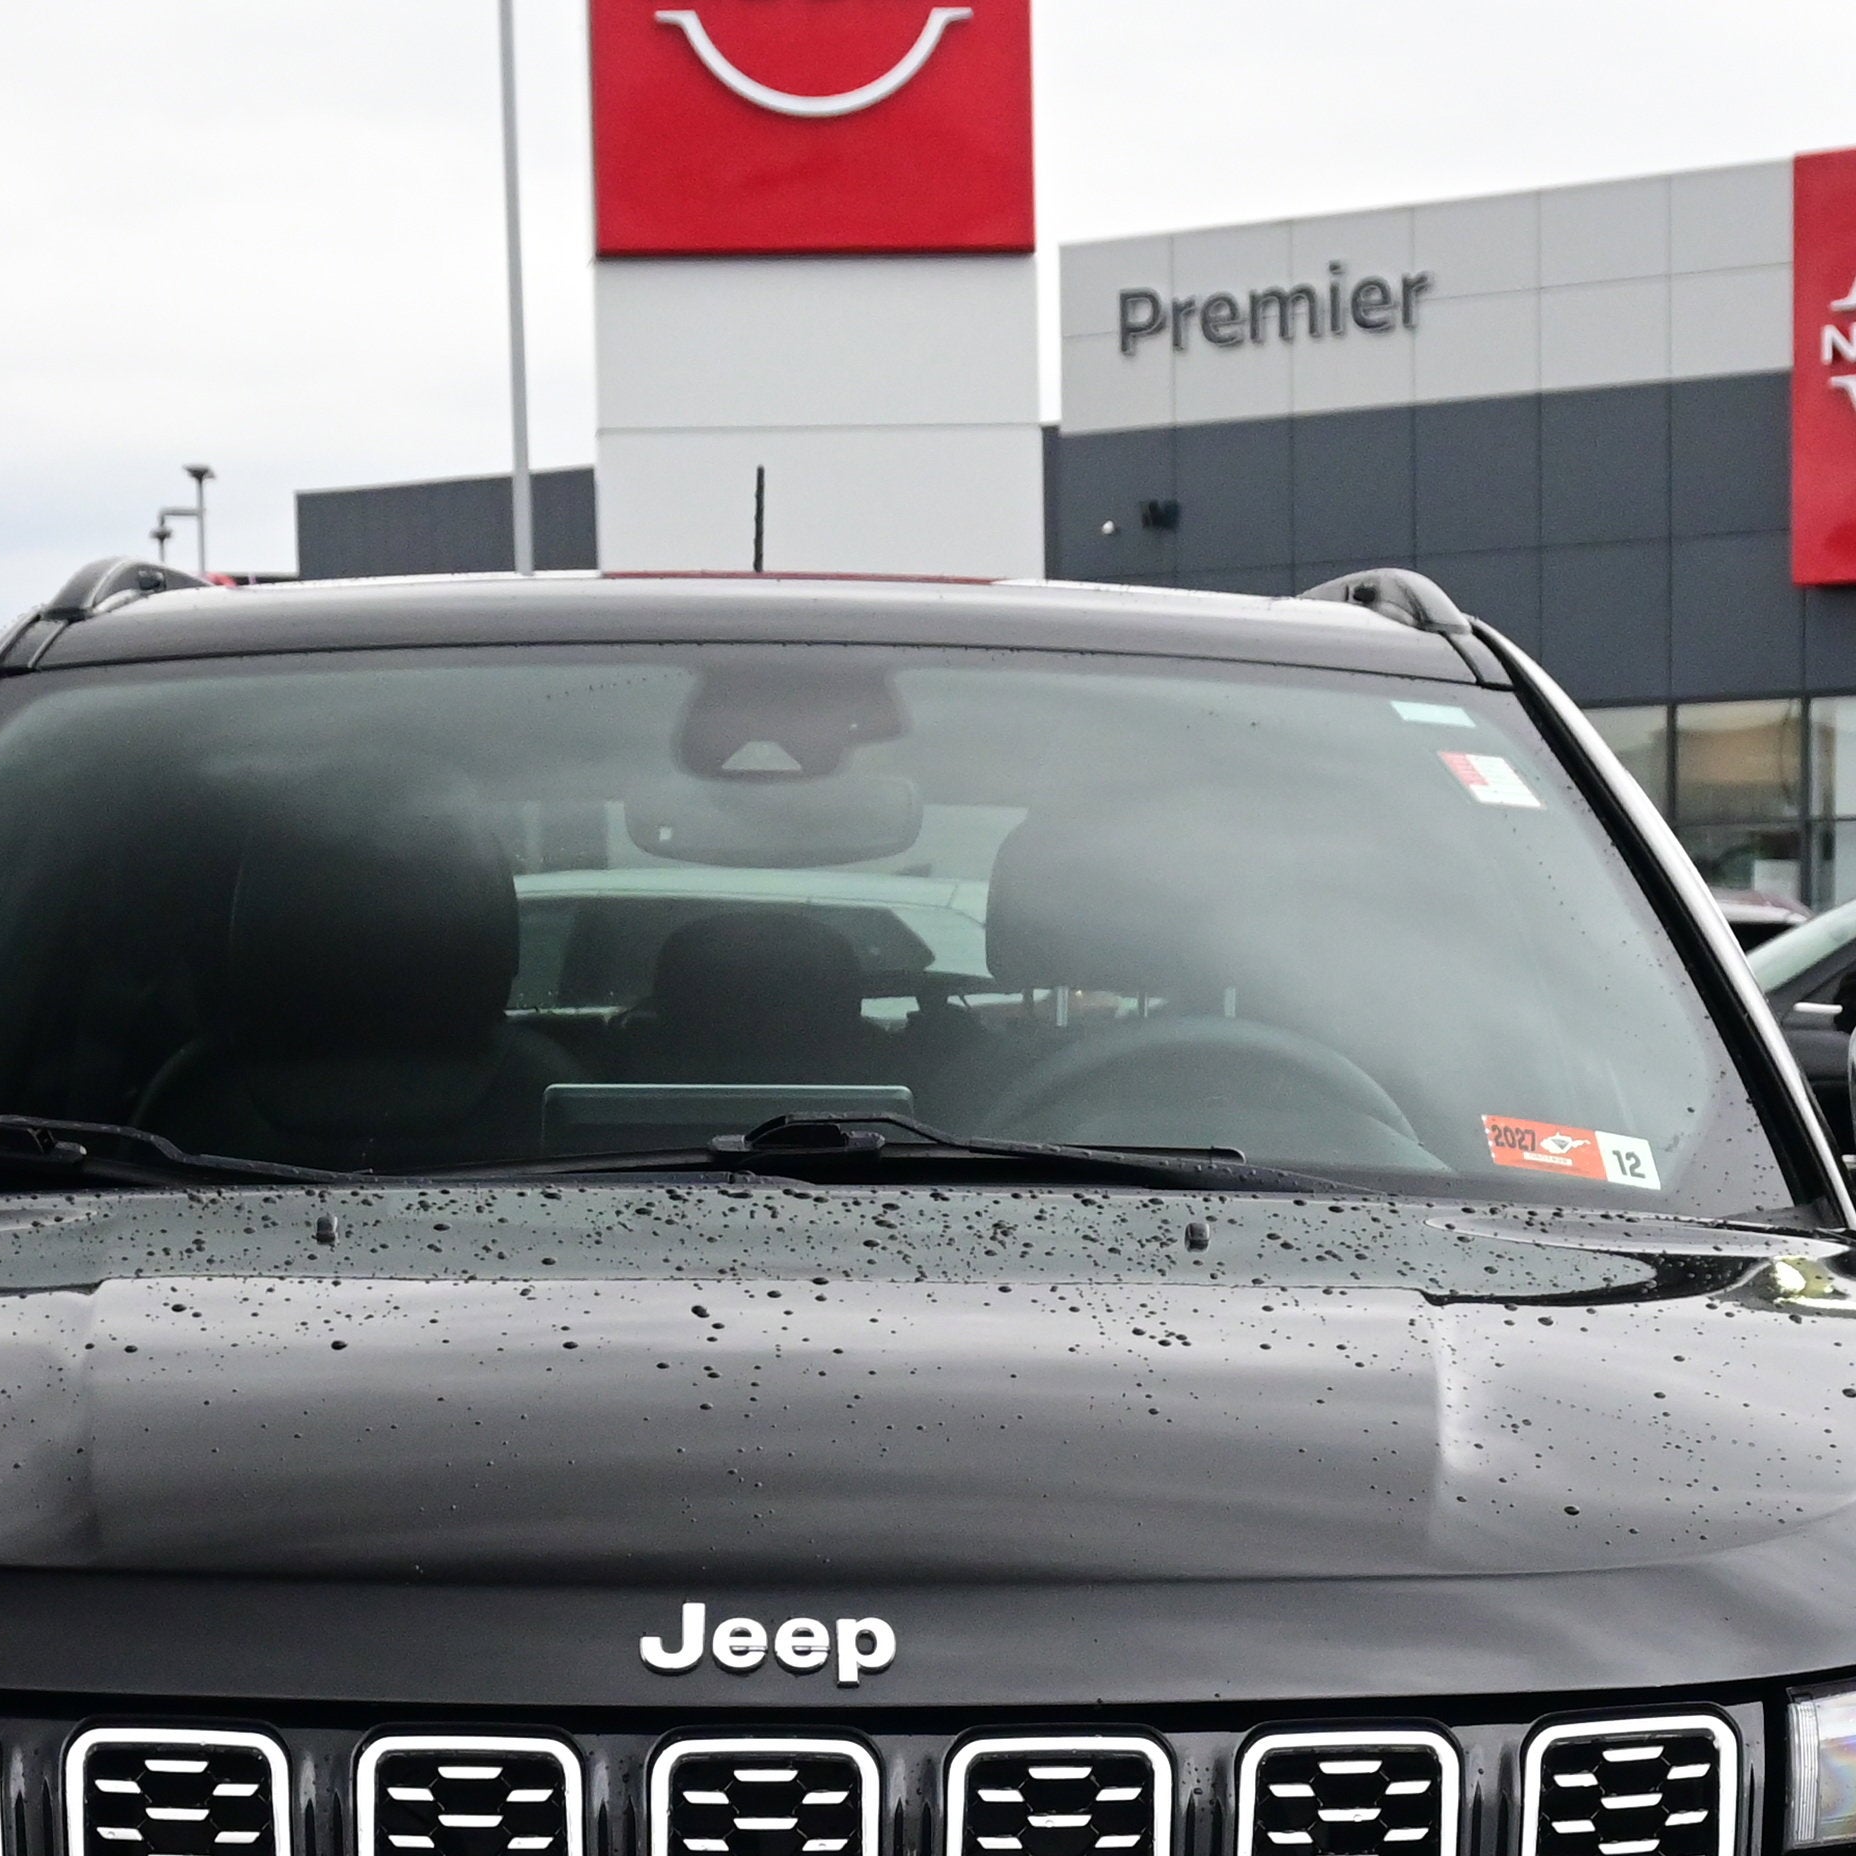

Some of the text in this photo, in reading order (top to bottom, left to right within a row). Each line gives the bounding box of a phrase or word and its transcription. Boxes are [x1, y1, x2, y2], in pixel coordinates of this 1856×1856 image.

[1119, 260, 1431, 355] Premier
[1490, 1123, 1536, 1152] 2027
[1611, 1149, 1646, 1179] 12
[639, 1601, 896, 1688] Jeep
